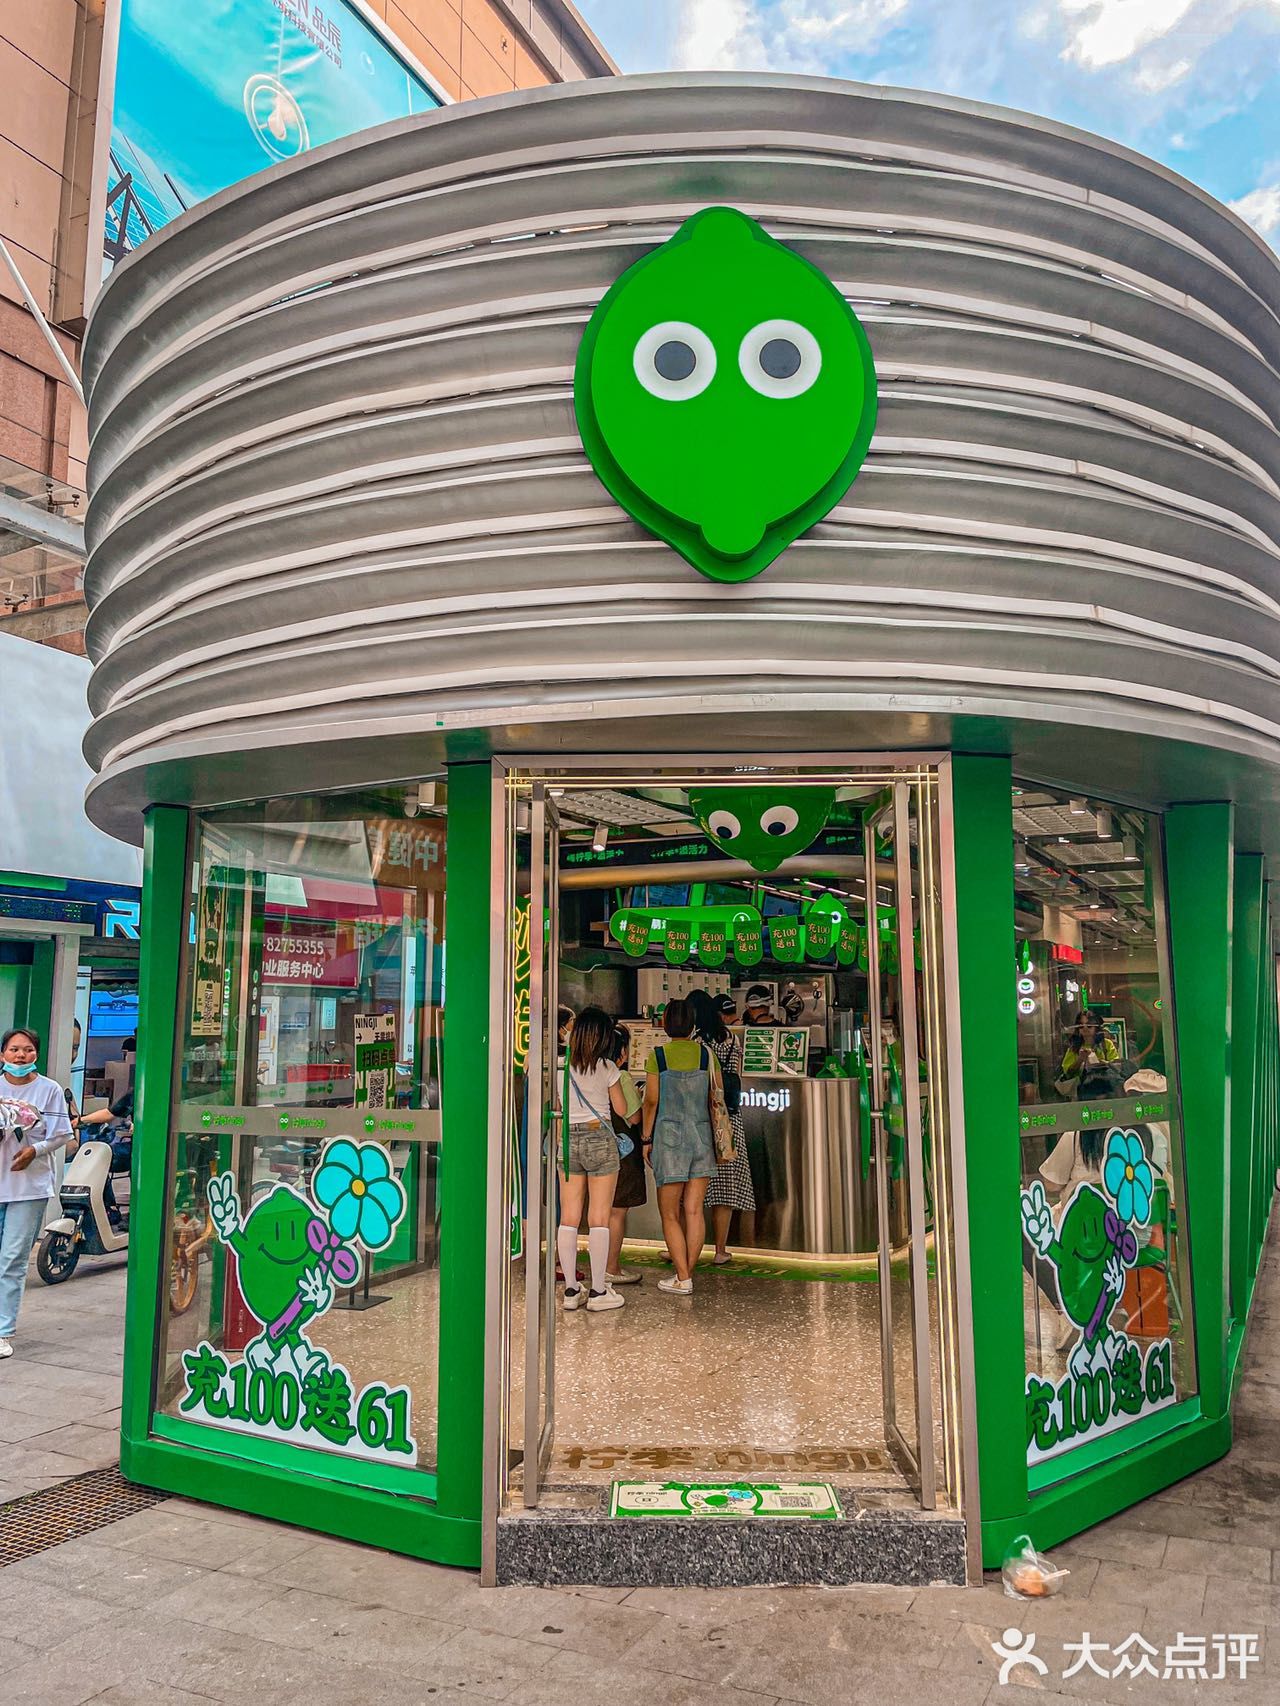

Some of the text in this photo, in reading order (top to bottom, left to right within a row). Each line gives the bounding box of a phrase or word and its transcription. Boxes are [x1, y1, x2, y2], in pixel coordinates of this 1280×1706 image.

[627, 923, 648, 935] 充100
[773, 928, 797, 938] 充100
[808, 923, 830, 934] 充100
[627, 934, 644, 944] 送61
[667, 930, 689, 940] 充100
[701, 932, 724, 942] 充100
[736, 932, 759, 942] 充100
[809, 934, 827, 944] 送61
[668, 941, 686, 950] 送61
[702, 942, 721, 952] 送61
[738, 942, 757, 952] 送61
[776, 938, 796, 949] 送61
[355, 1018, 378, 1030] NINGJI
[739, 1087, 791, 1112] ningji
[181, 1345, 414, 1455] 充100送61
[1025, 1342, 1175, 1451] 充100送61
